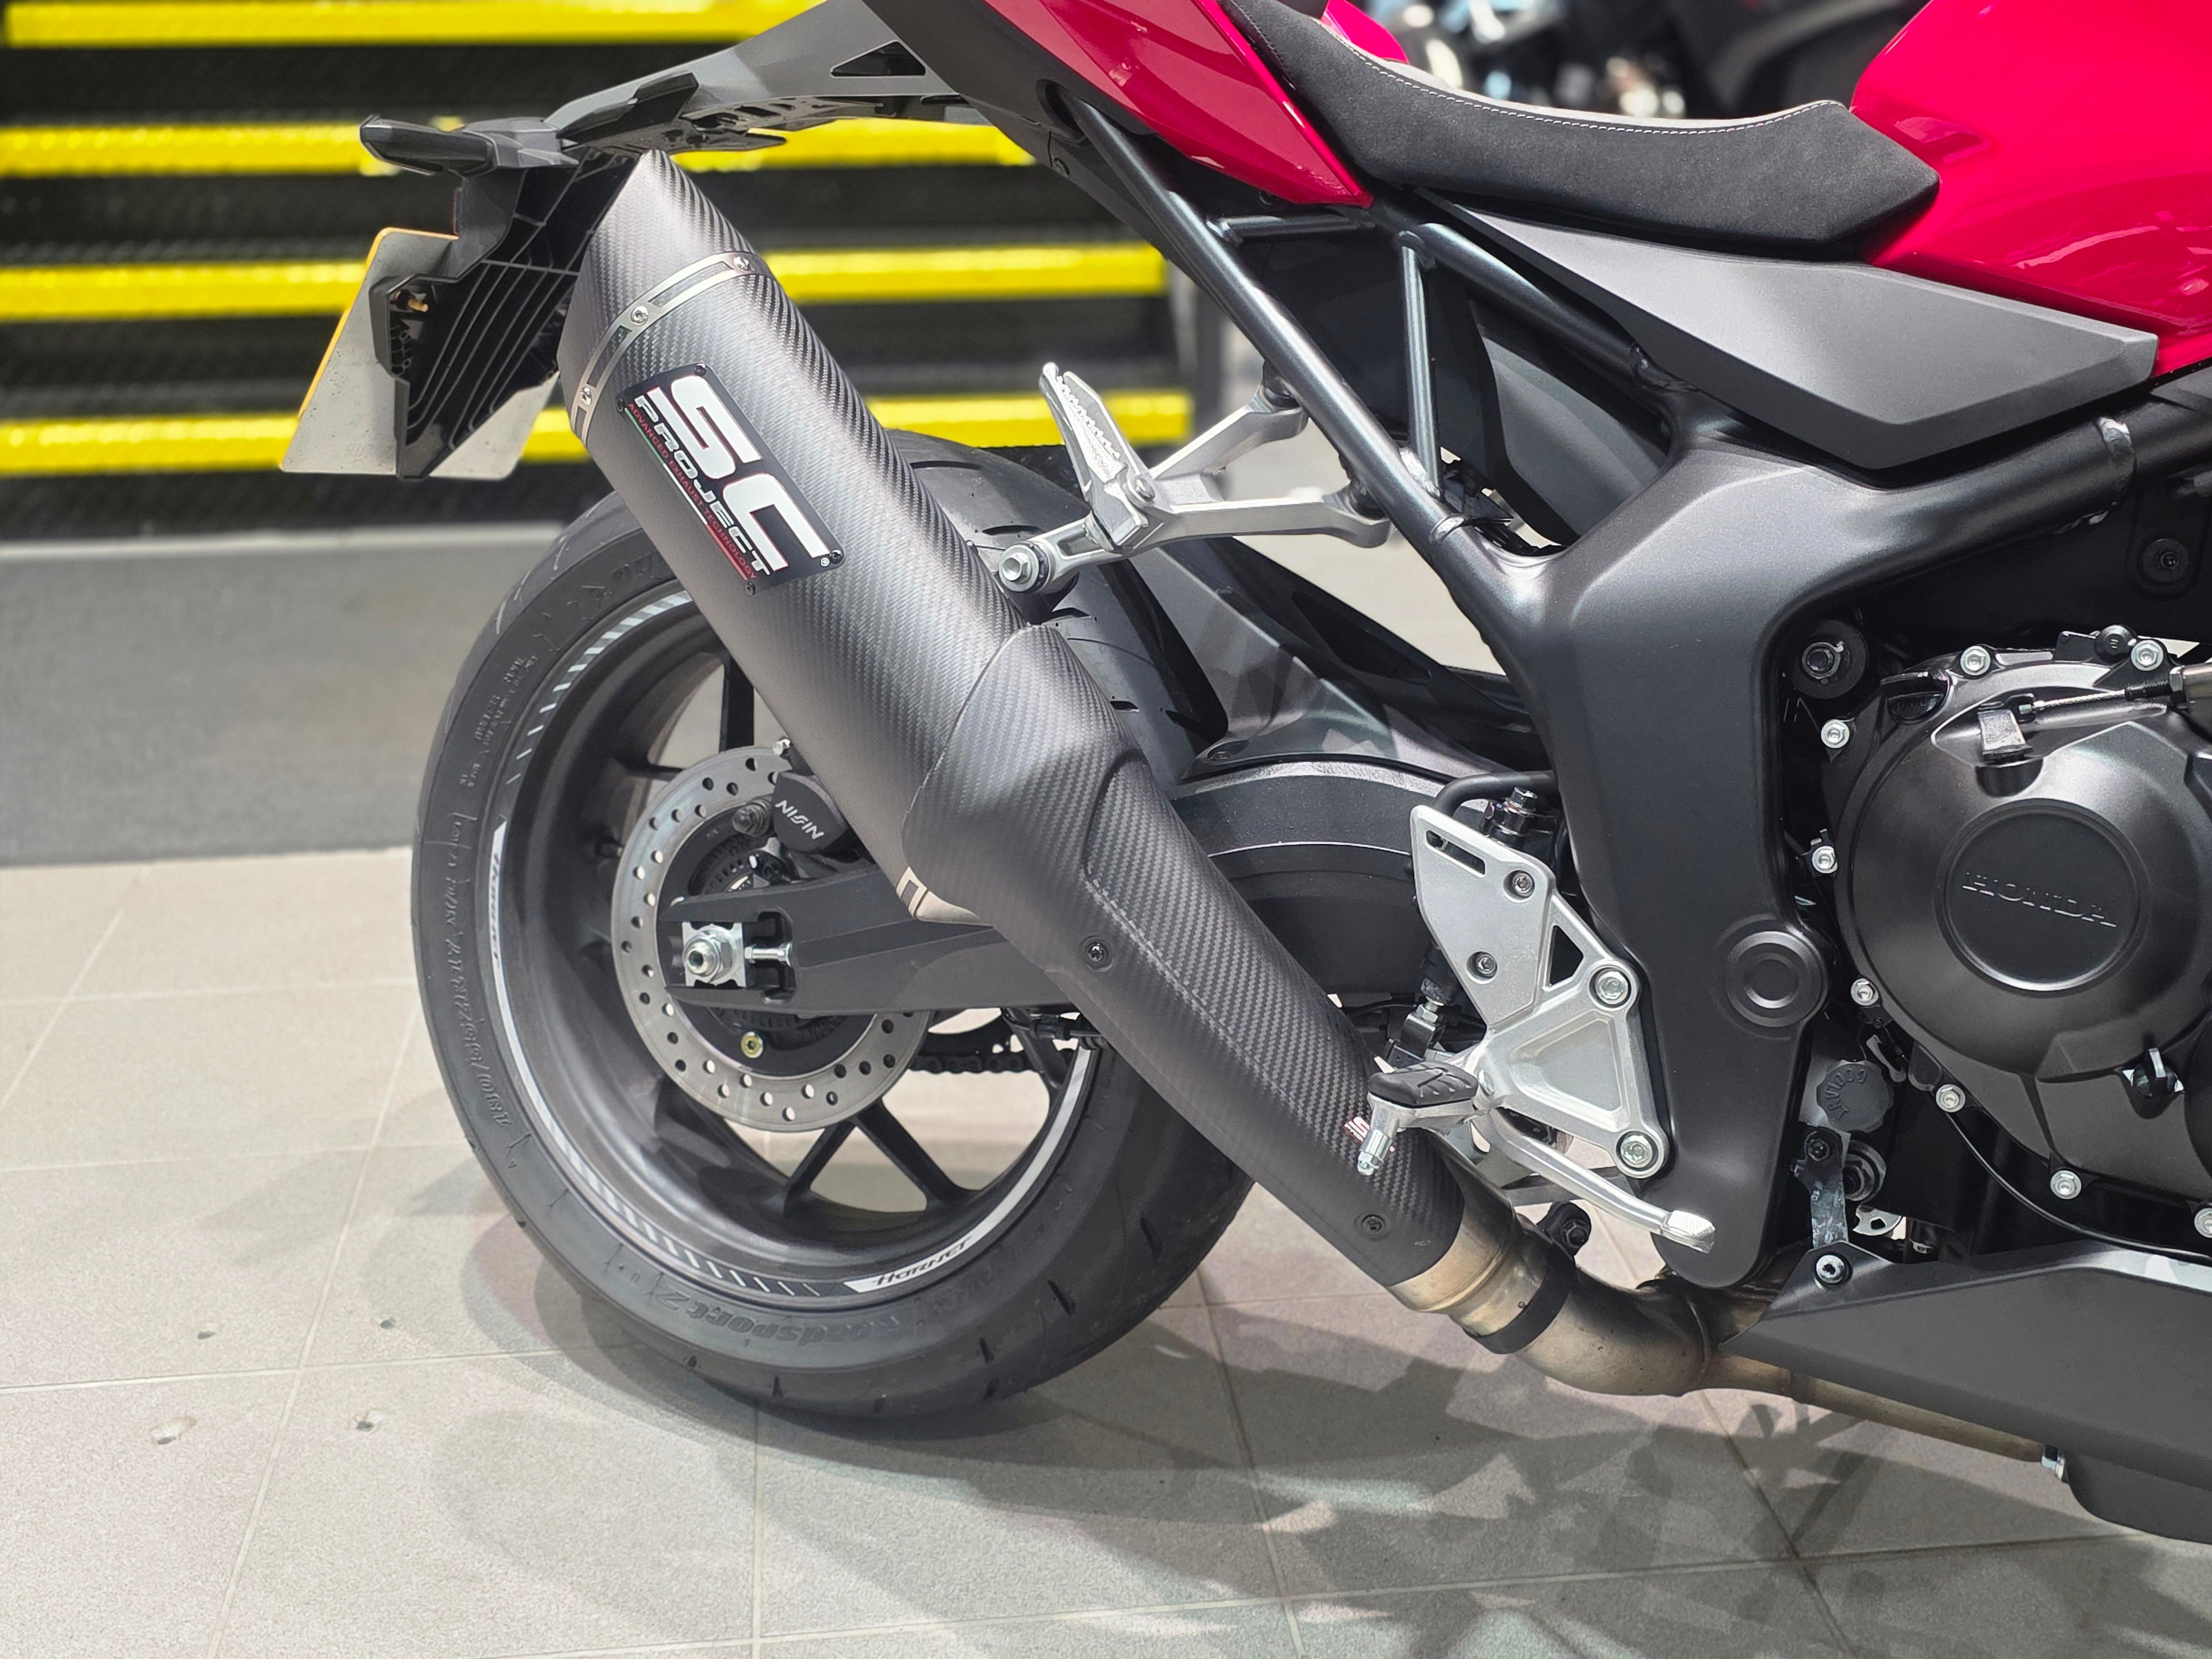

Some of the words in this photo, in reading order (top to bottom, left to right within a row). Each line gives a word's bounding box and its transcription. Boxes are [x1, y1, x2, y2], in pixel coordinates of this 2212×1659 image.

[627, 403, 669, 460] ADVANCED
[669, 461, 704, 507] EXHAUST
[703, 505, 757, 580] TECHNOLOGY
[634, 394, 771, 576] PROJECT
[646, 374, 830, 571] SC
[1962, 872, 2117, 928] HONDA
[872, 1236, 973, 1287] HORNET
[690, 1303, 900, 1348] Roadsport
